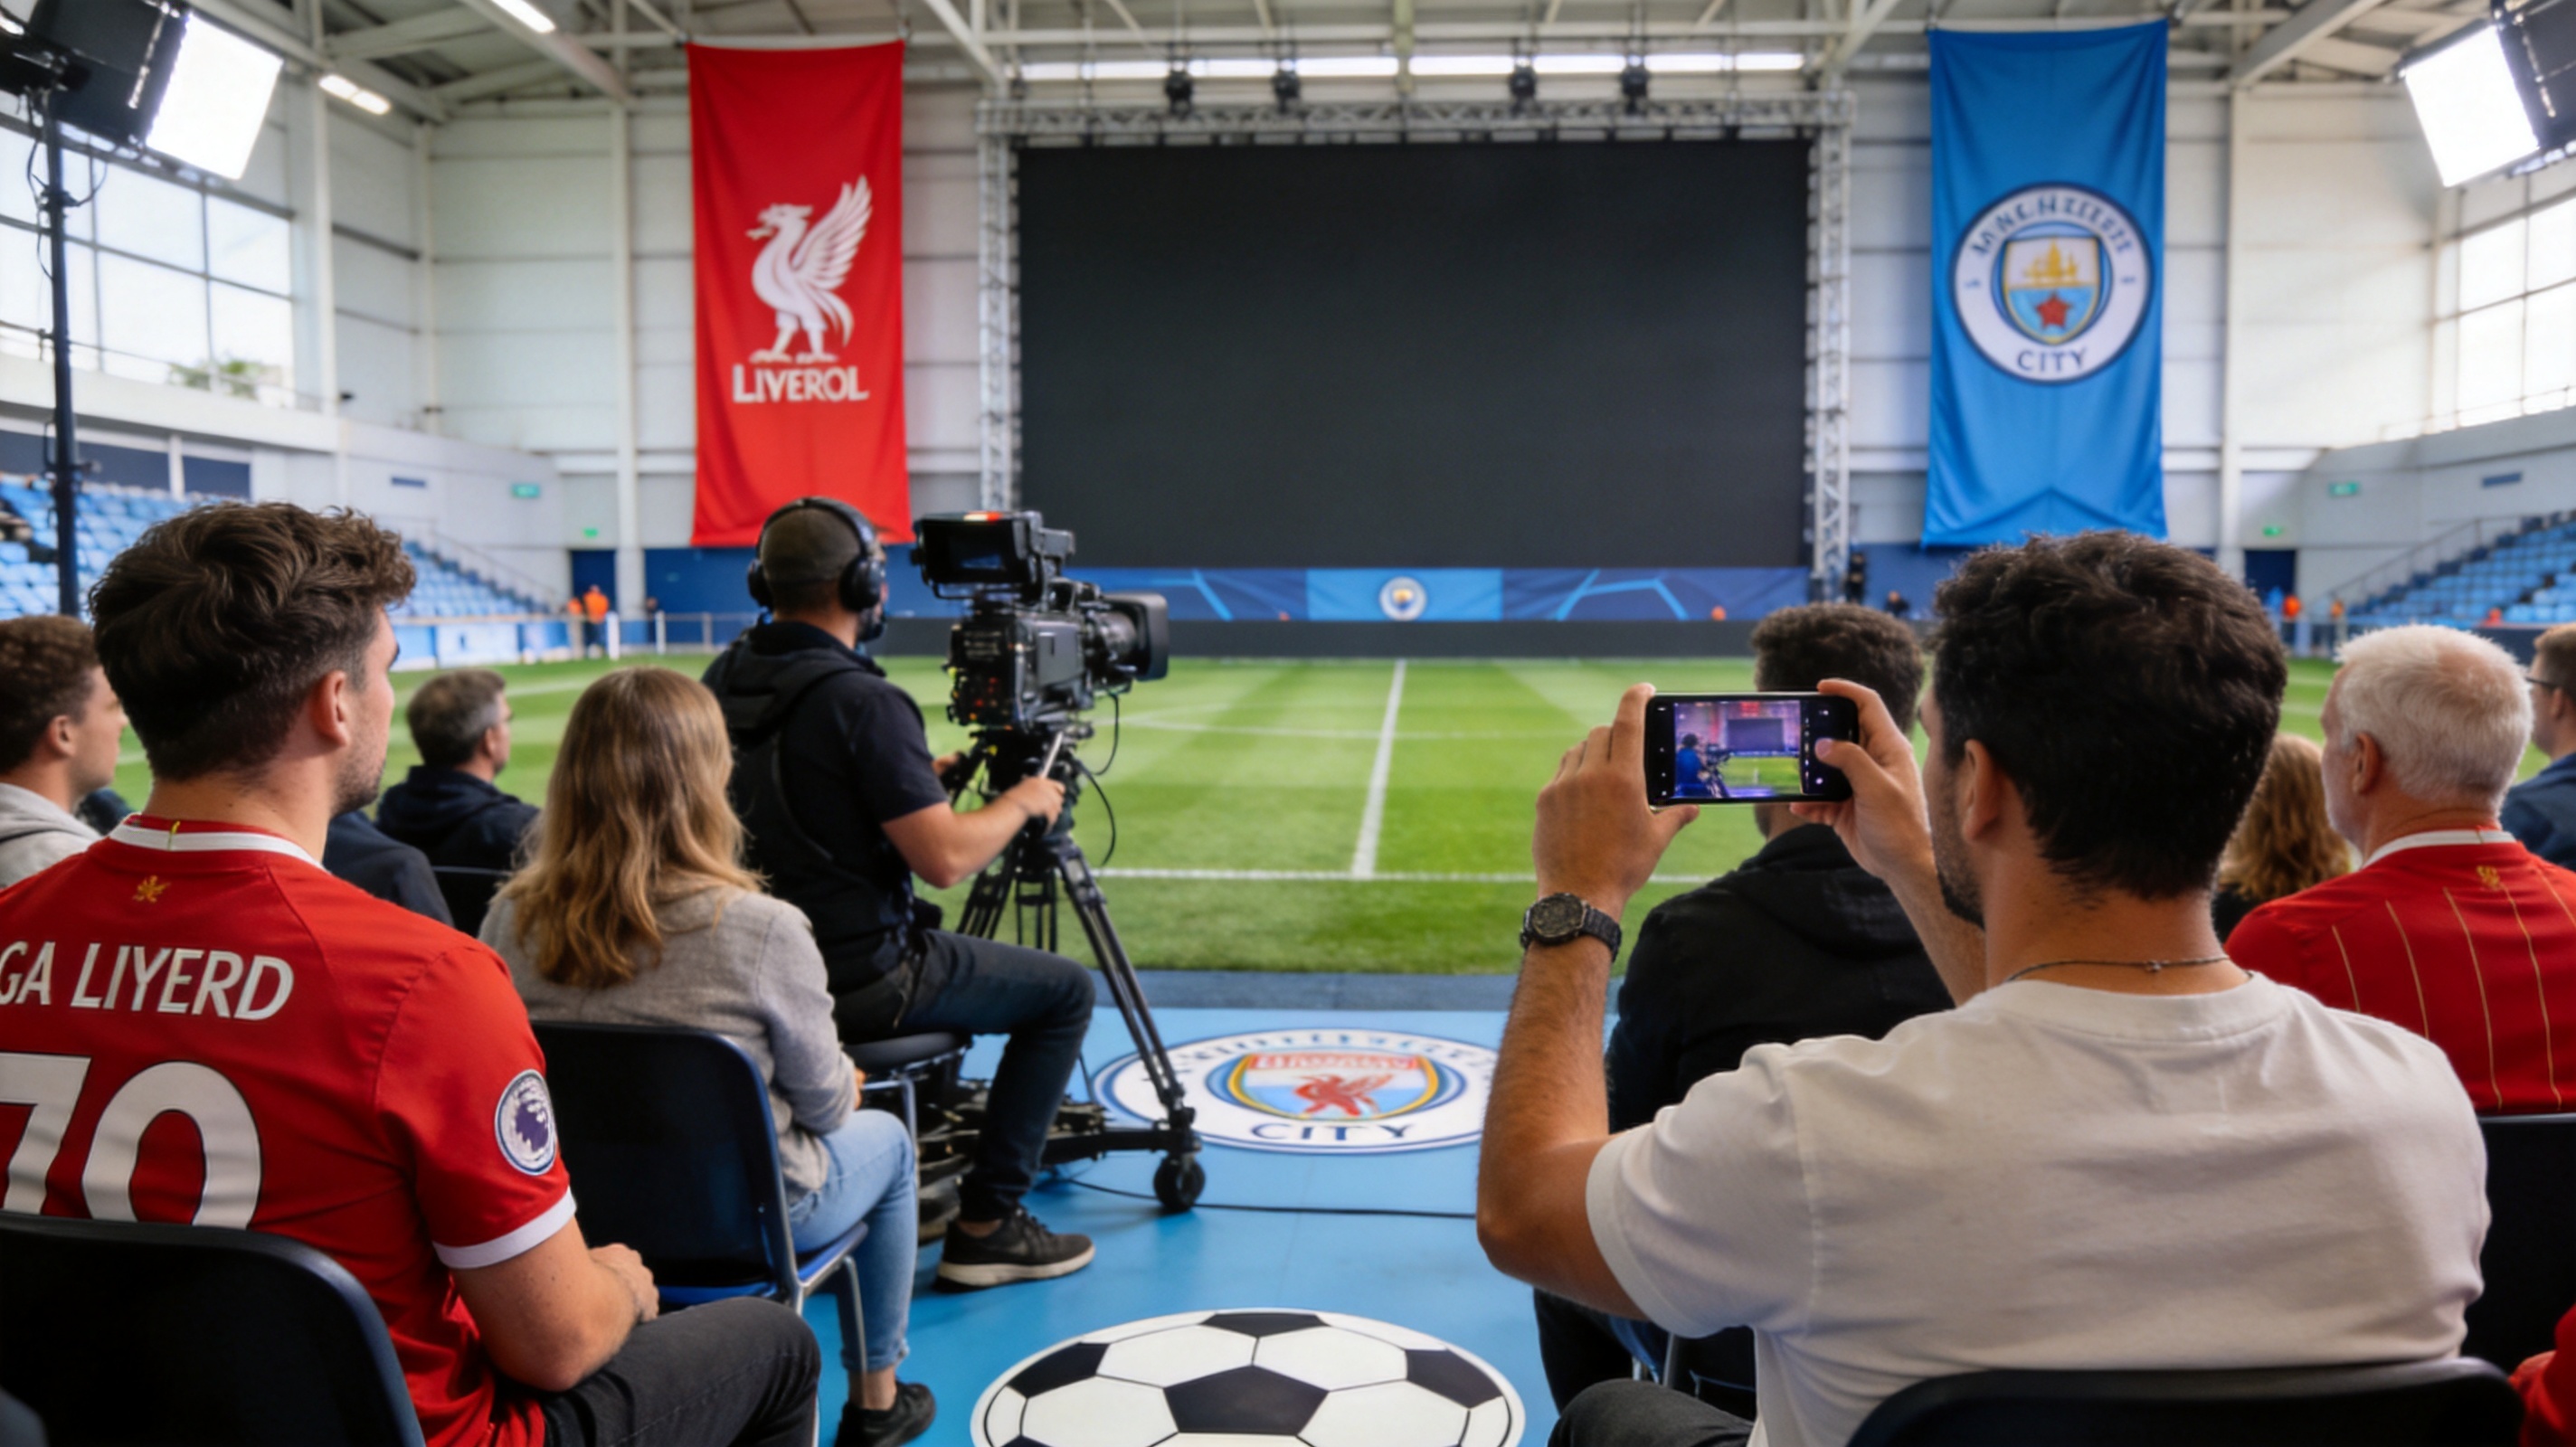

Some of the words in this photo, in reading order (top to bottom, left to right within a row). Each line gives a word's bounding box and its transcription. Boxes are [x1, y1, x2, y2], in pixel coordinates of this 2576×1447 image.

[2016, 347, 2087, 373] CITY
[732, 364, 871, 403] LIVEROL
[70, 942, 295, 1022] LIYERD
[1250, 1122, 1413, 1142] CITY
